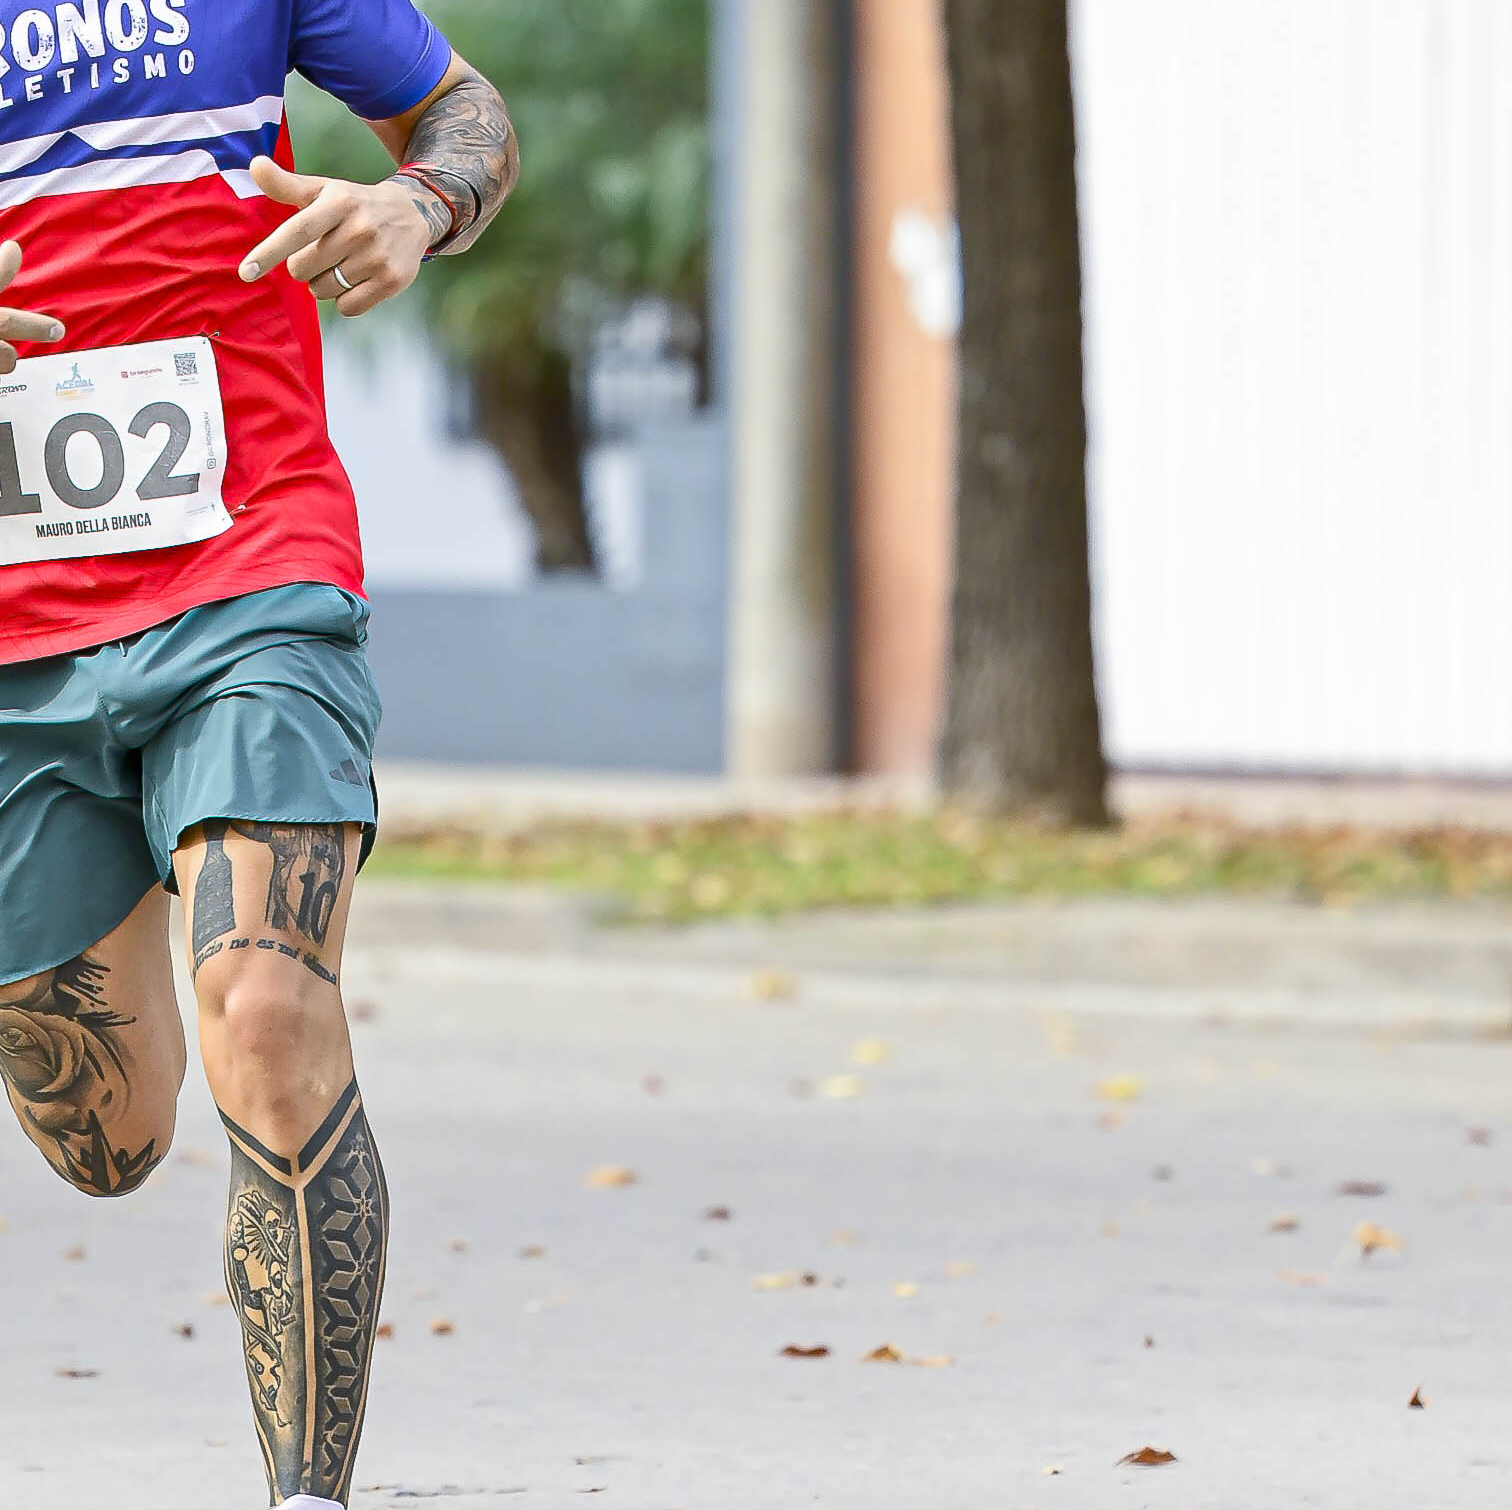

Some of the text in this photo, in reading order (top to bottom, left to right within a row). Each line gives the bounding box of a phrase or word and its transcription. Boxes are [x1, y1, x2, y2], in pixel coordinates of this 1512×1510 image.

[35, 512, 152, 539] MAURO DELLA BIANCA
[297, 871, 338, 945] 10
